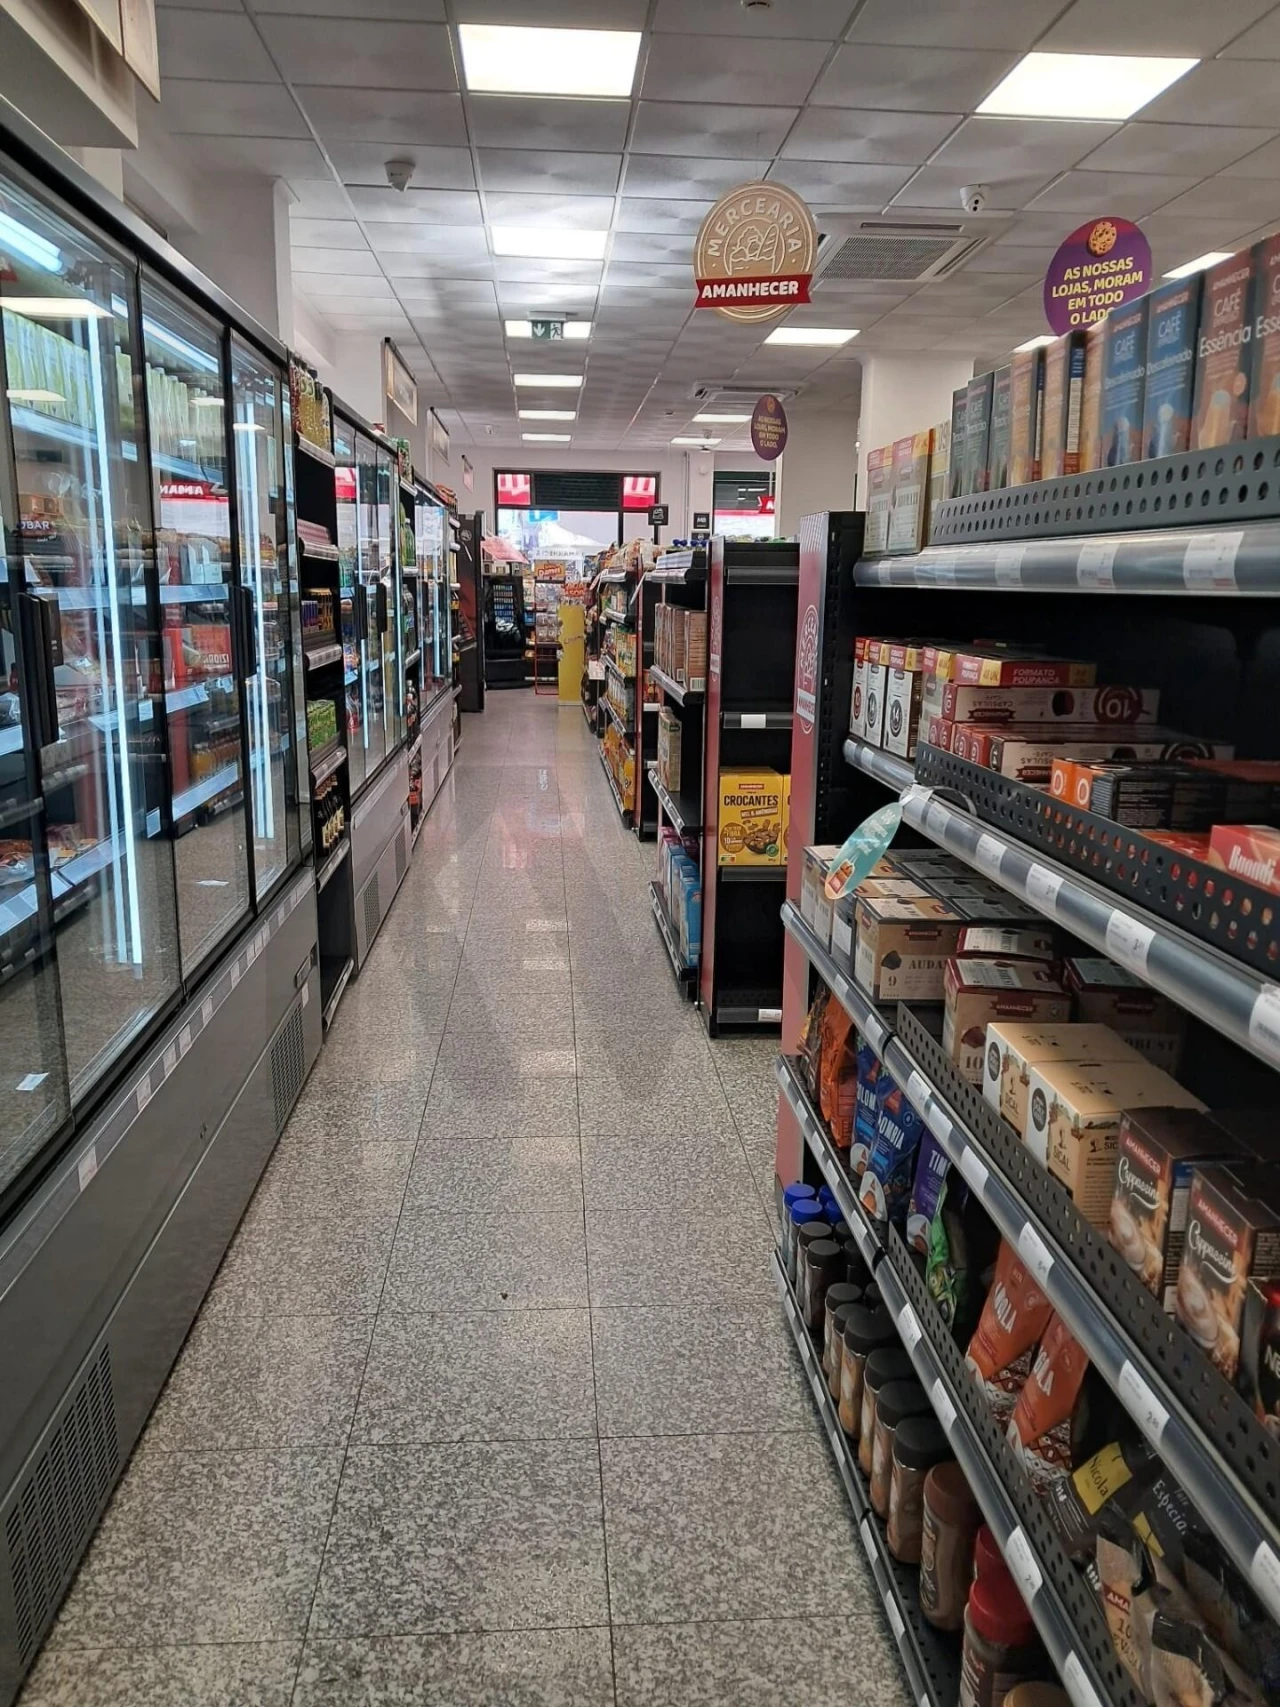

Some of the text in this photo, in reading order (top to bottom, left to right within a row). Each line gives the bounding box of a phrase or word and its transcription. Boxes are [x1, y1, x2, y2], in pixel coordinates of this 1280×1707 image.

[707, 198, 802, 257] MERCEARIA
[1064, 257, 1134, 281] AS NOSSAS
[701, 281, 799, 299] AMANHECER
[1052, 271, 1143, 298] LOJAS, MORAM
[1068, 290, 1124, 310] EM TODO
[1070, 313, 1080, 325] O
[1200, 325, 1252, 358] Essência
[1013, 668, 1055, 677] FORMATO
[1105, 699, 1131, 719] 10
[724, 795, 778, 806] CROCANTES
[888, 975, 897, 987] 9
[965, 1055, 984, 1070] 10
[1053, 1146, 1071, 1172] SICAL
[1089, 1455, 1109, 1497] Nicola
